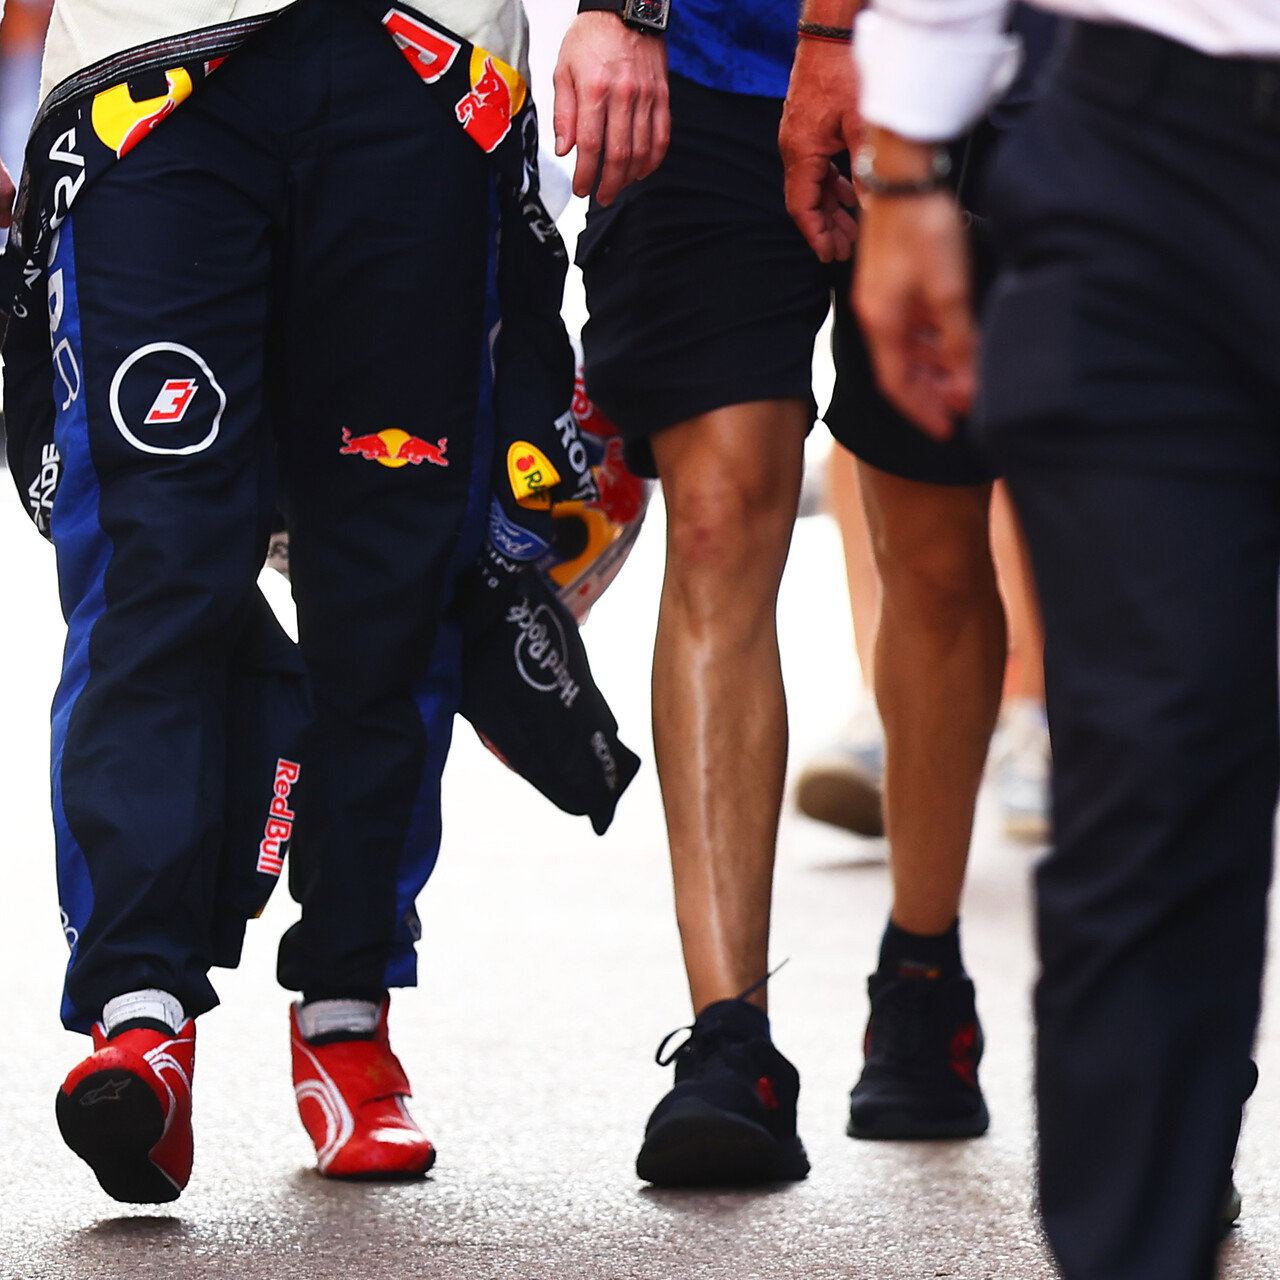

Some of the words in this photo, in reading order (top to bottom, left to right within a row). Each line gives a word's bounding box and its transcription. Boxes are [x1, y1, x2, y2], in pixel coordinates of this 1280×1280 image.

[148, 380, 194, 420] 3
[538, 642, 581, 709] Hard
[270, 760, 300, 820] Red
[258, 818, 292, 874] Bull
